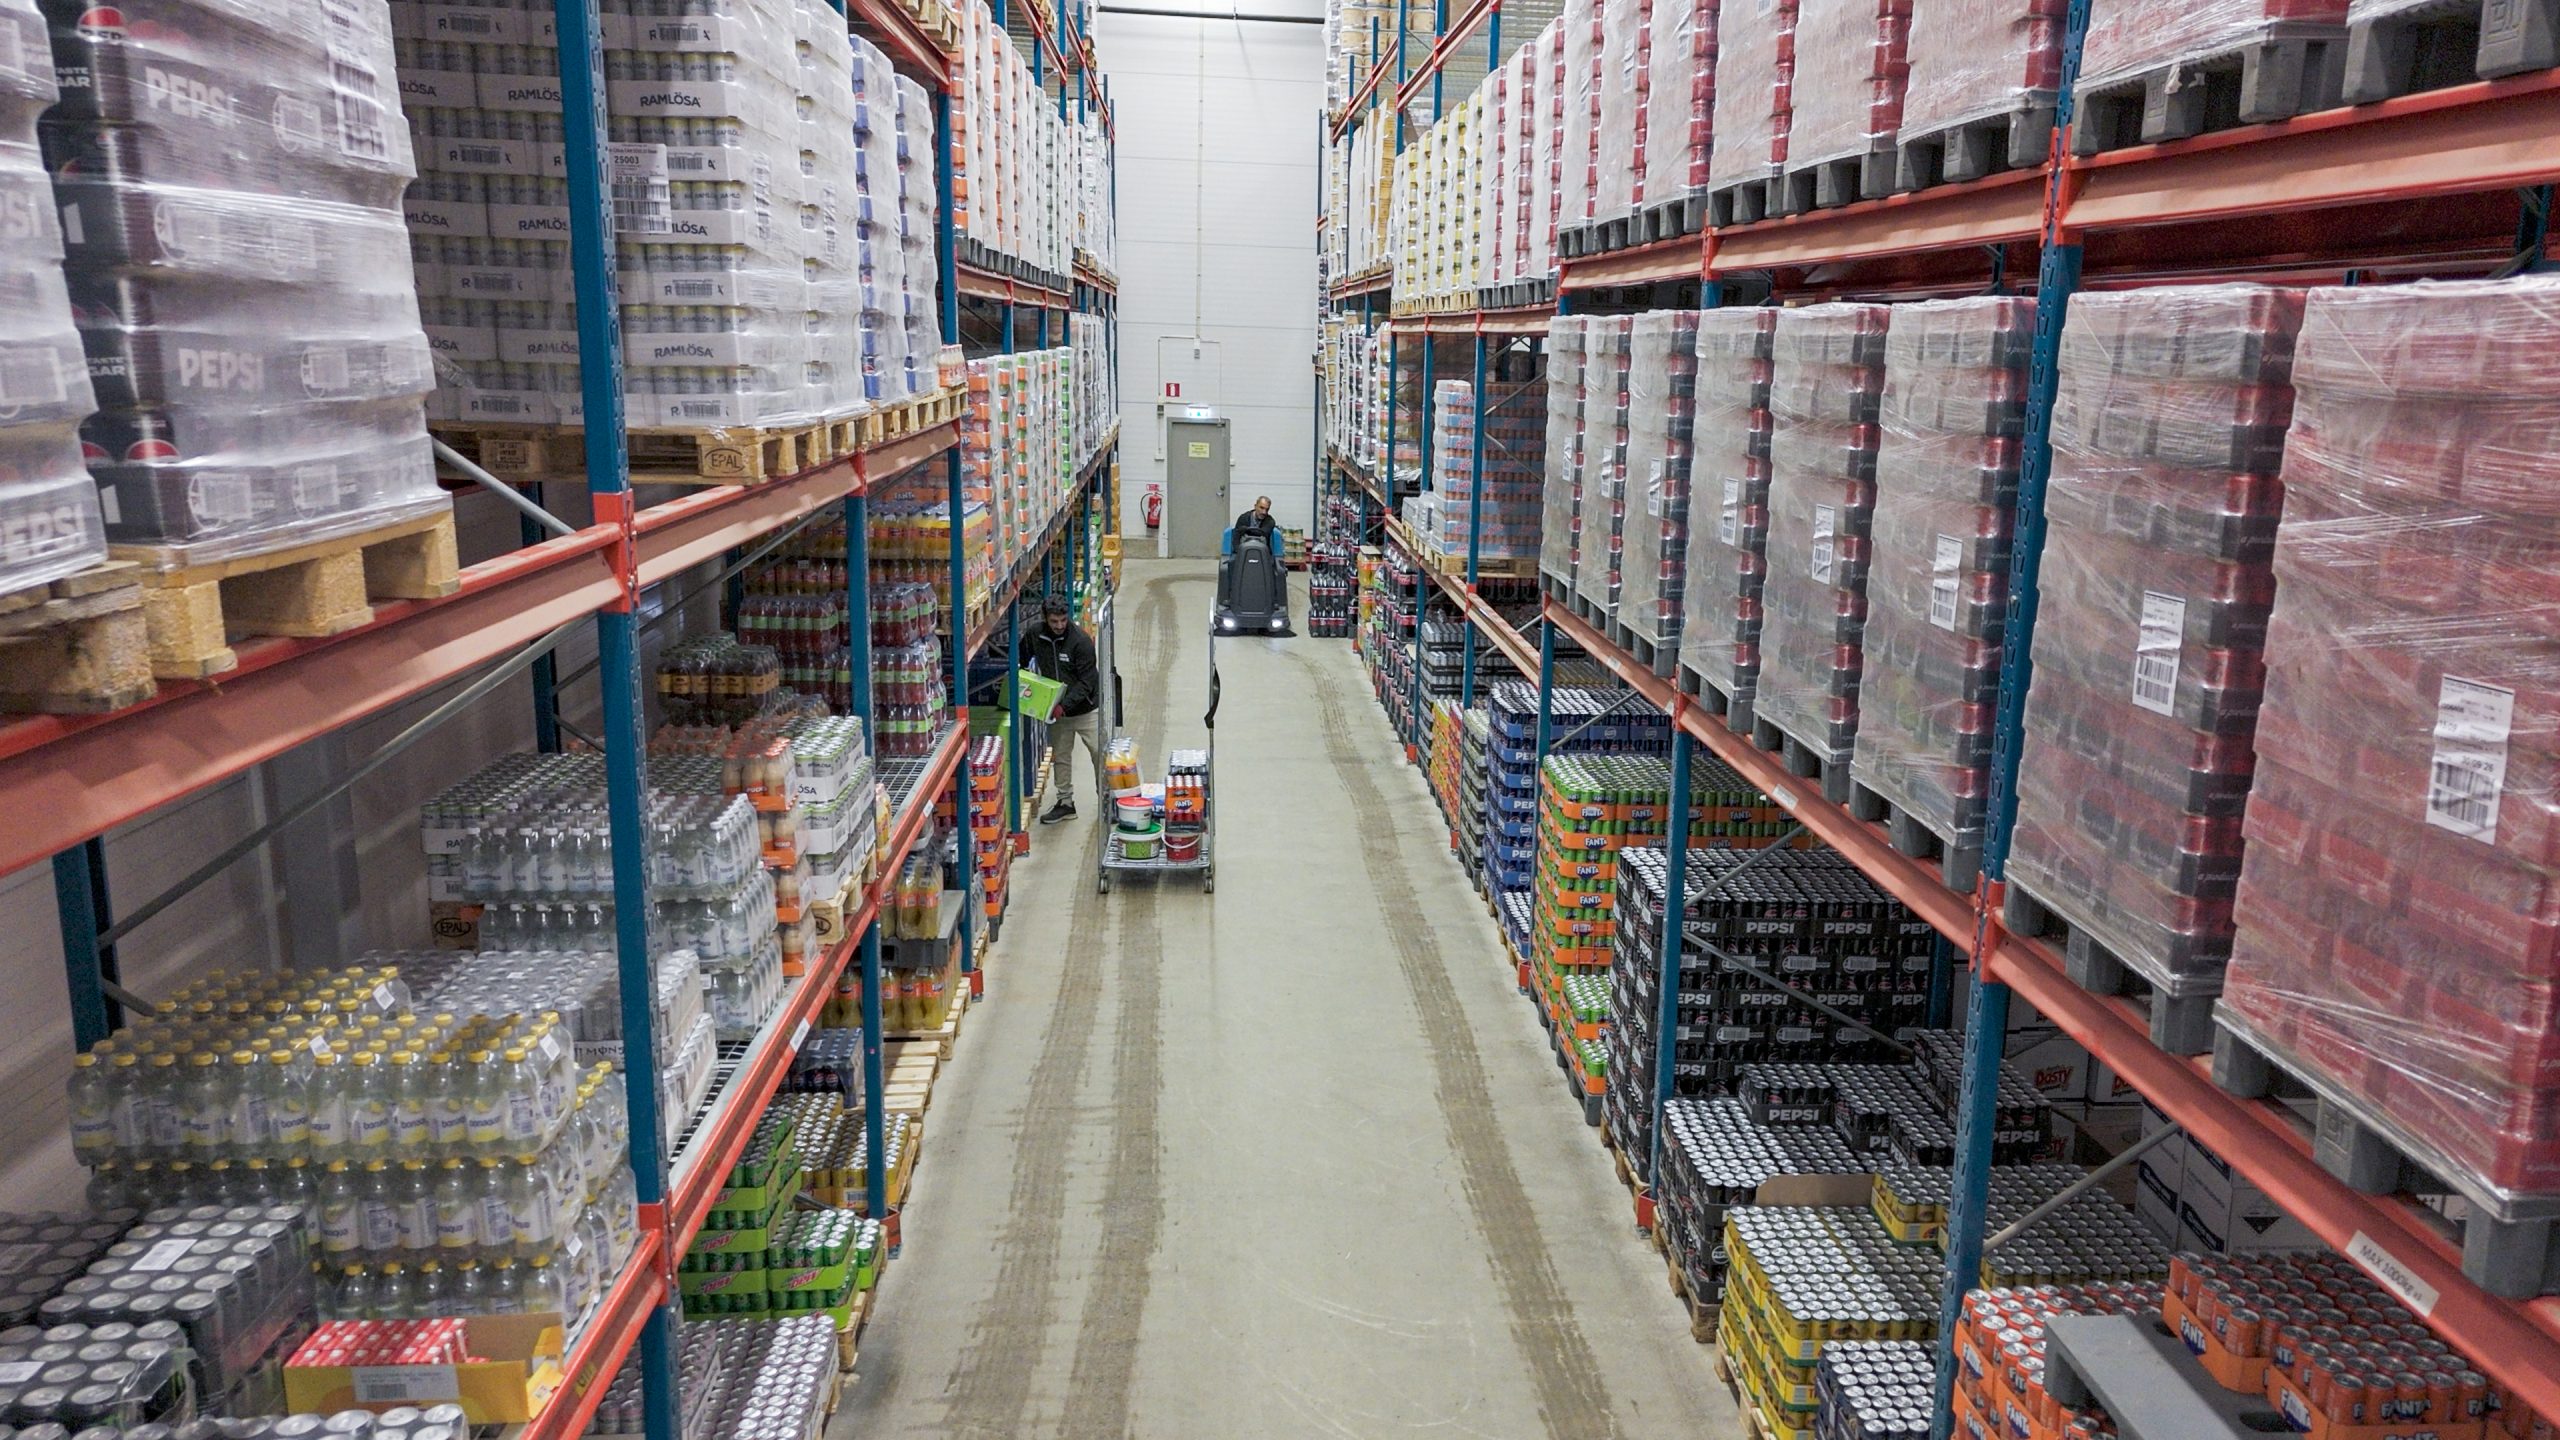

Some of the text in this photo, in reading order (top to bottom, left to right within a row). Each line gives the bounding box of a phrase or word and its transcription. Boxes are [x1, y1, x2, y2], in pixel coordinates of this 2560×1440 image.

[56, 76, 91, 88] GAR
[398, 79, 437, 97] LÖSA
[508, 87, 561, 101] RAMLÖS
[640, 92, 701, 107] RAMLÖSA
[404, 210, 448, 228] MLÖSA
[672, 221, 707, 236] LÖSA
[528, 341, 577, 355] RAMLÖS
[654, 343, 714, 358] RAMLÖSA
[87, 365, 126, 376] GAR
[178, 348, 265, 389] PEPSI
[711, 454, 739, 469] EPAL
[0, 503, 89, 563] EPSI
[1516, 752, 1537, 761] PEP
[1514, 801, 1535, 809] PEP
[1585, 837, 1607, 846] FANTA
[1648, 839, 1668, 848] FANT
[1512, 850, 1533, 858] PEP
[1577, 866, 1599, 875] FANTA
[1580, 896, 1602, 904] FANTA
[1682, 922, 1932, 934] EPSI PEPSI PEPSI PEP
[1677, 994, 1711, 1005] EPSI
[1740, 994, 1788, 1005] PEPSI
[1892, 994, 1924, 1005] PEP
[1674, 1064, 1707, 1076] EPSI
[1769, 1109, 1819, 1121] PEPSI
[2360, 1245, 2384, 1269] MAX
[2382, 1262, 2415, 1297] 1000kg
[2180, 1313, 2207, 1352] FANTA
